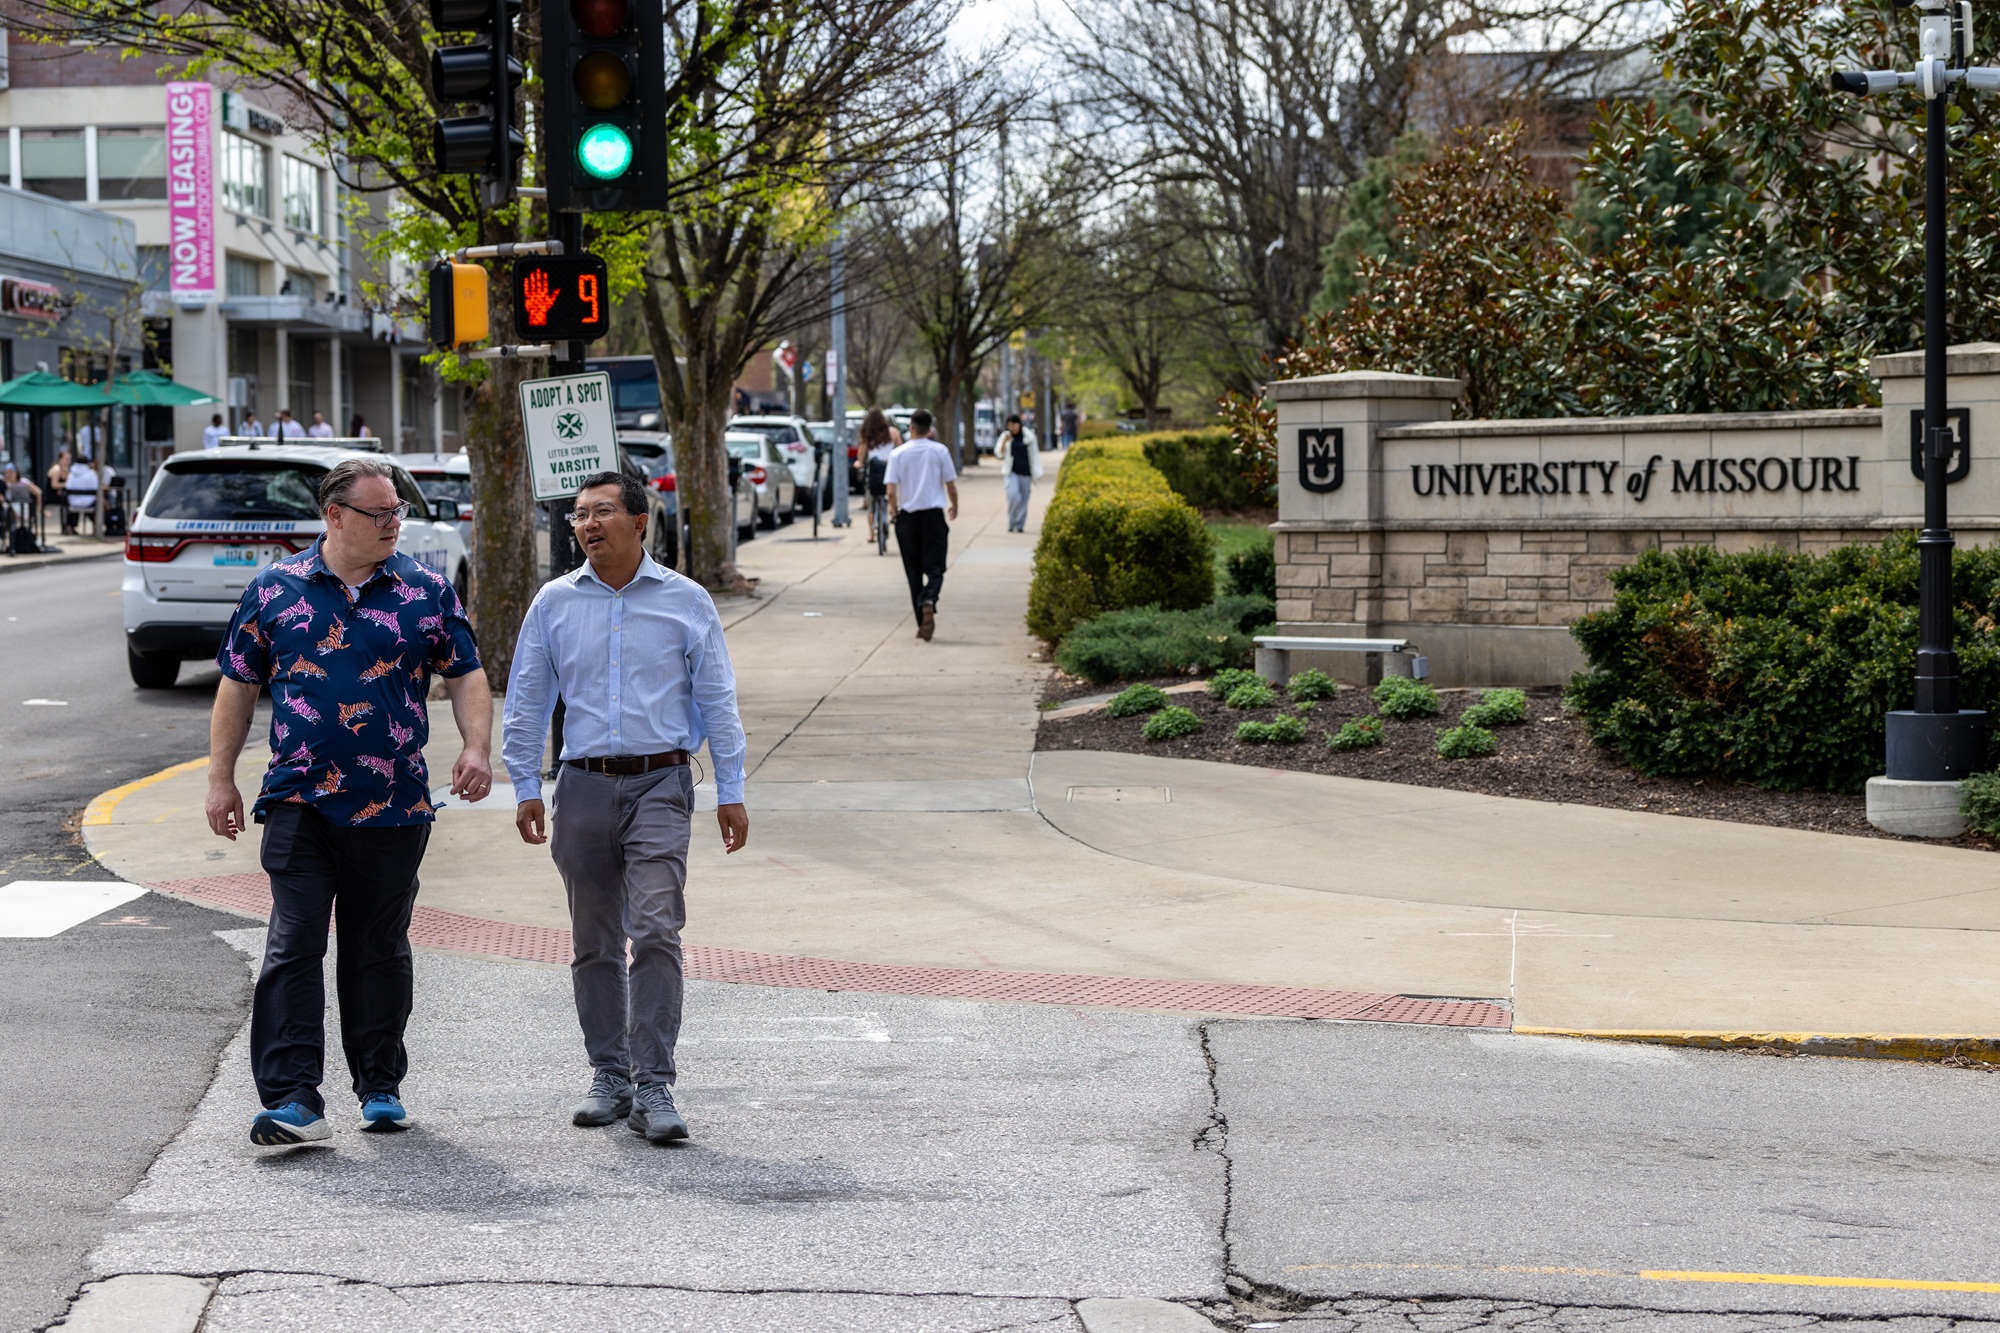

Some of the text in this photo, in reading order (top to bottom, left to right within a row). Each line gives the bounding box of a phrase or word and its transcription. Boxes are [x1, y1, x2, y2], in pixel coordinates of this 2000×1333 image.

[170, 86, 196, 208] LEASING!
[173, 214, 198, 285] NOW
[578, 274, 599, 322] 9
[530, 382, 602, 409] ADOPT A SPOT
[548, 445, 599, 459] LITTER CONTROL
[550, 457, 600, 475] VARSITY
[1411, 455, 1860, 501] UNIVERSITY of MISSOURI
[561, 473, 593, 489] CLIP
[176, 521, 296, 531] COMMUNITY SERVICE AIDE
